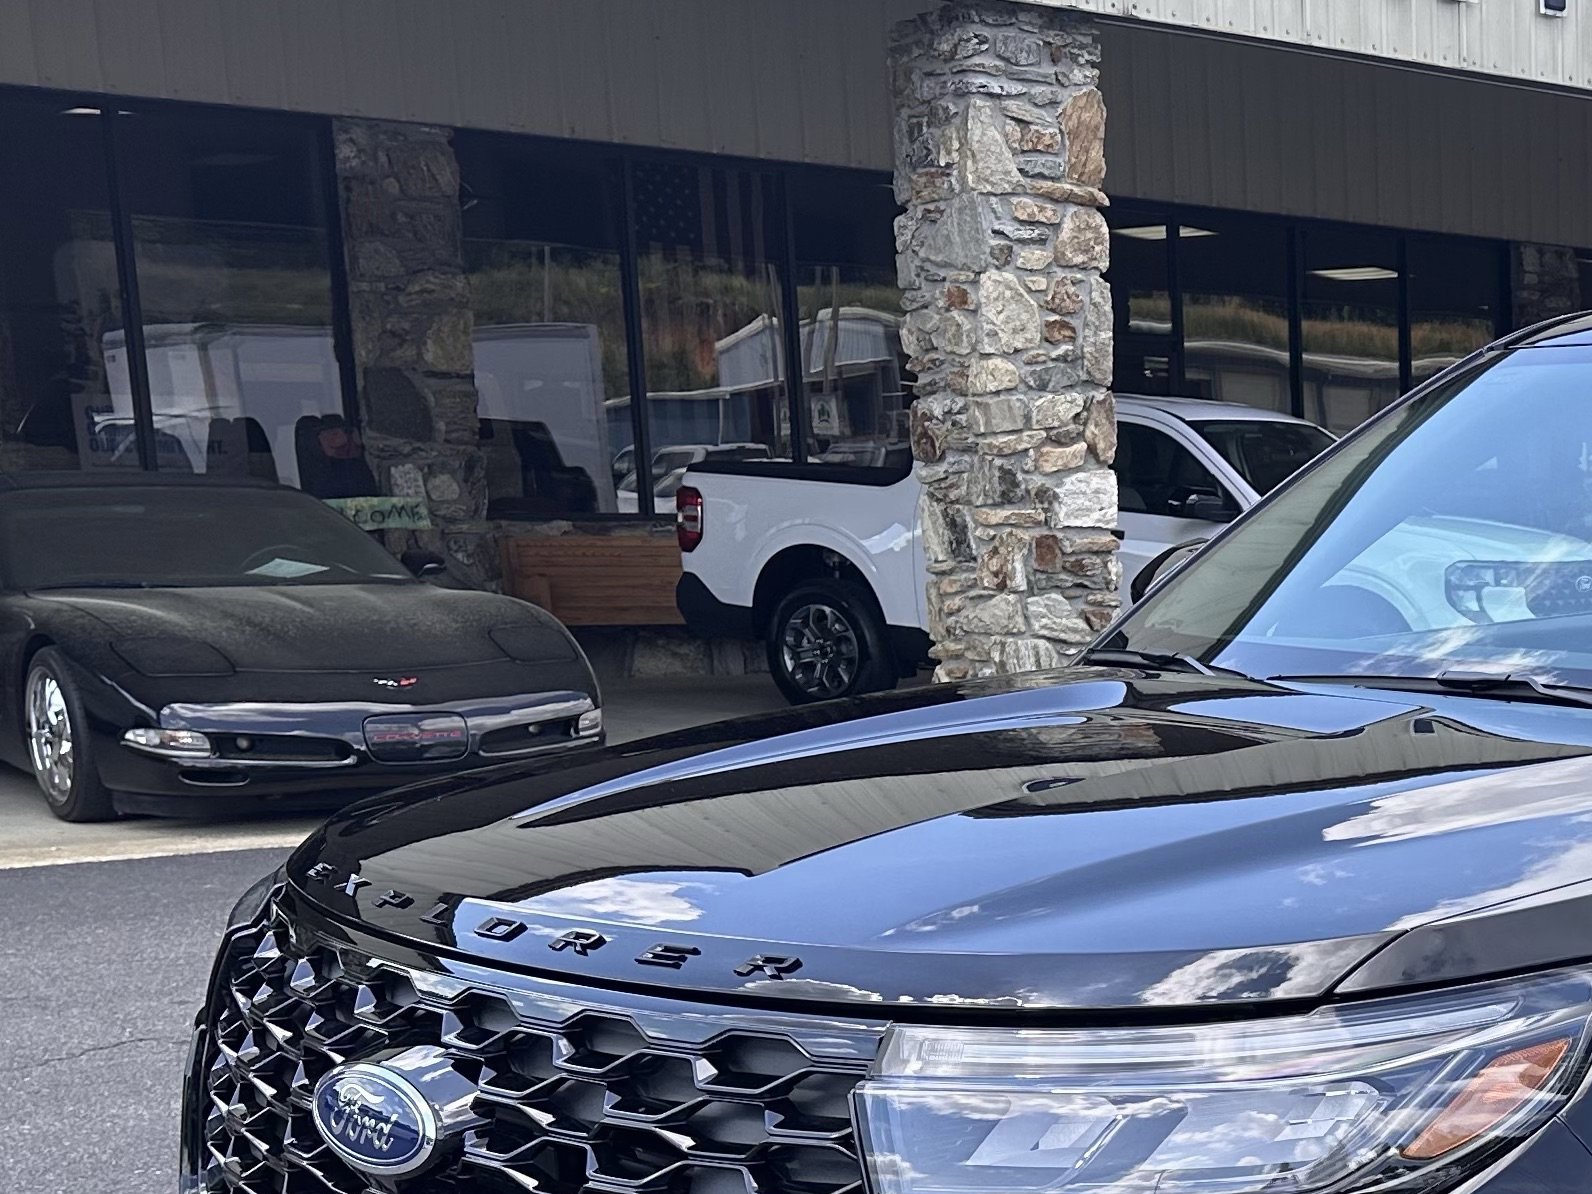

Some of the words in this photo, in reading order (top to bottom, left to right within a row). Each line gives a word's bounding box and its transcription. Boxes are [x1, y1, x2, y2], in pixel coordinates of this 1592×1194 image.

[341, 503, 424, 525] COME
[305, 862, 804, 980] EXPLORER
[329, 1082, 400, 1152] Ford
